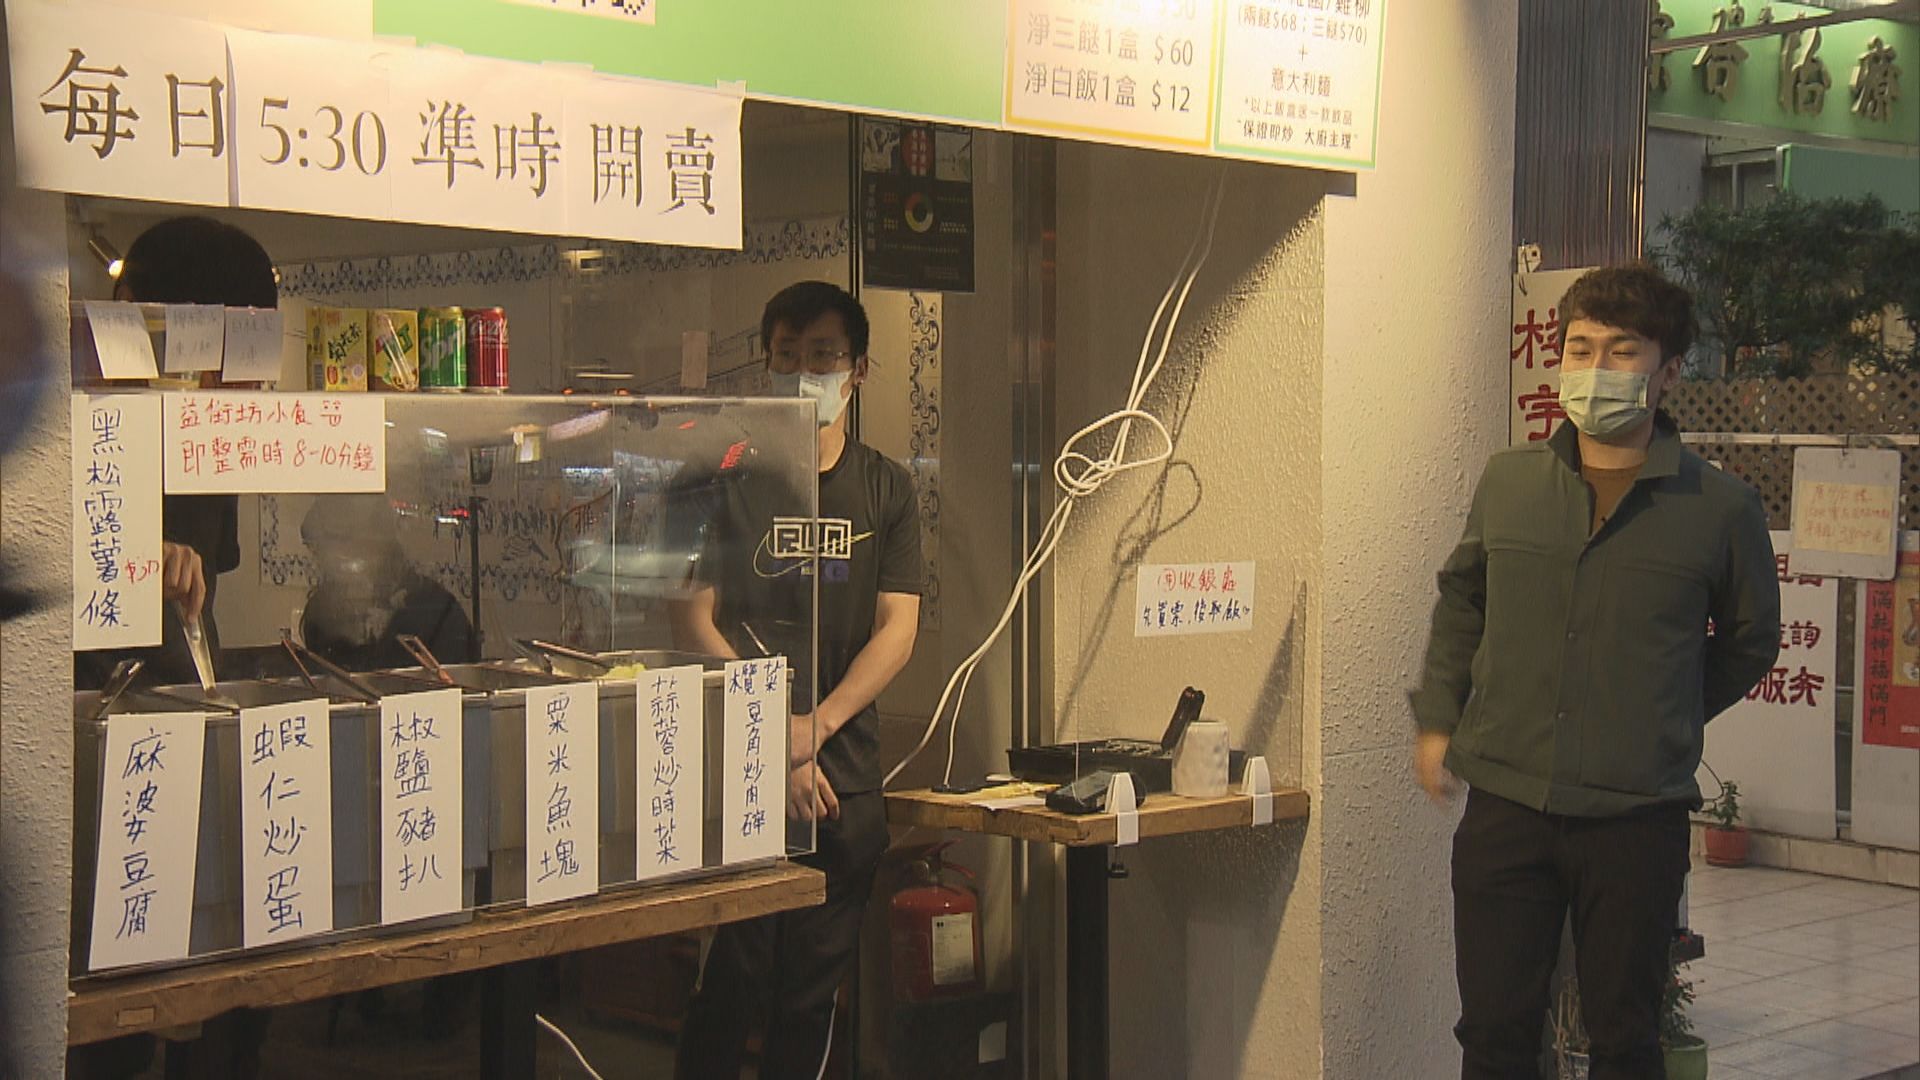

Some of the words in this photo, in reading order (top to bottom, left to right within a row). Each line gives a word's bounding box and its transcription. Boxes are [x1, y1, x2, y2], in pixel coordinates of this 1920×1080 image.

[79, 407, 124, 628] 黑松露薯條
[114, 726, 173, 940] 麻婆豆腐
[251, 715, 314, 935] 蝦仁炒蛋
